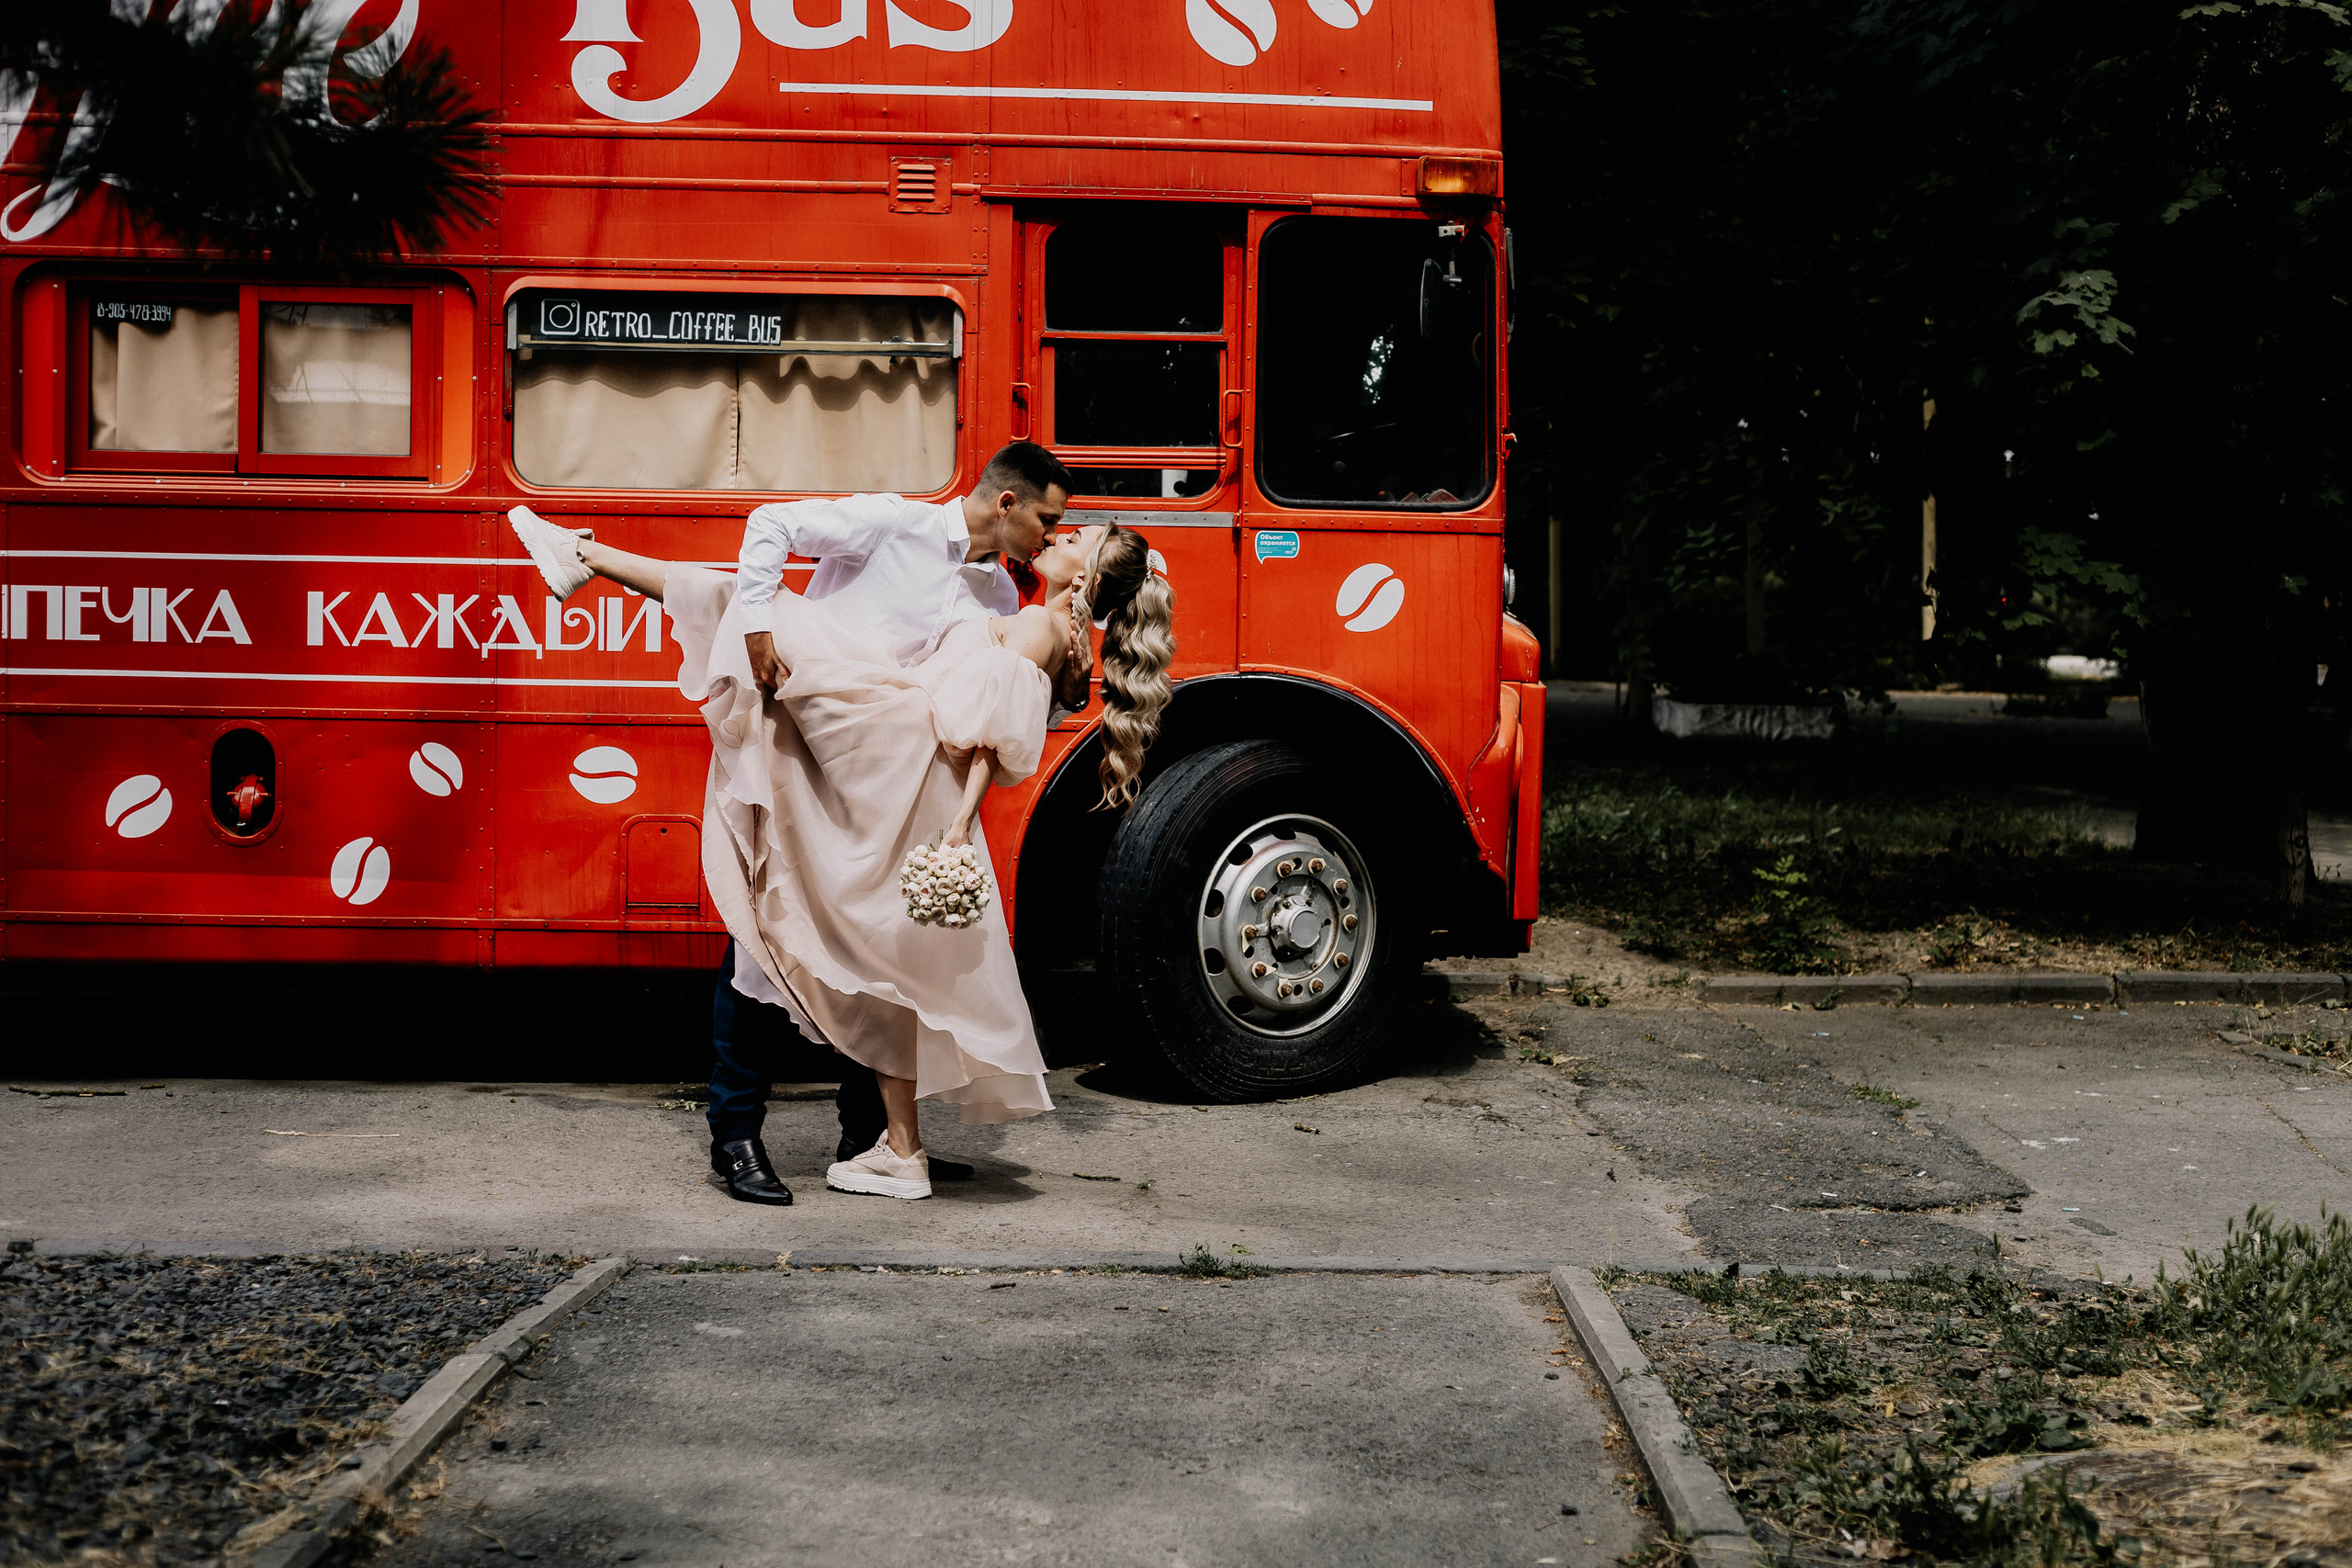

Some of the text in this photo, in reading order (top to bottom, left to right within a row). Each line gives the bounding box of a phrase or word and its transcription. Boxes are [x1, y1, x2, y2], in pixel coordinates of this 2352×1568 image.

[96, 302, 172, 321] 8-905-478-3994
[2, 584, 662, 659] ПЕЧКА КАЖДЫЙ
